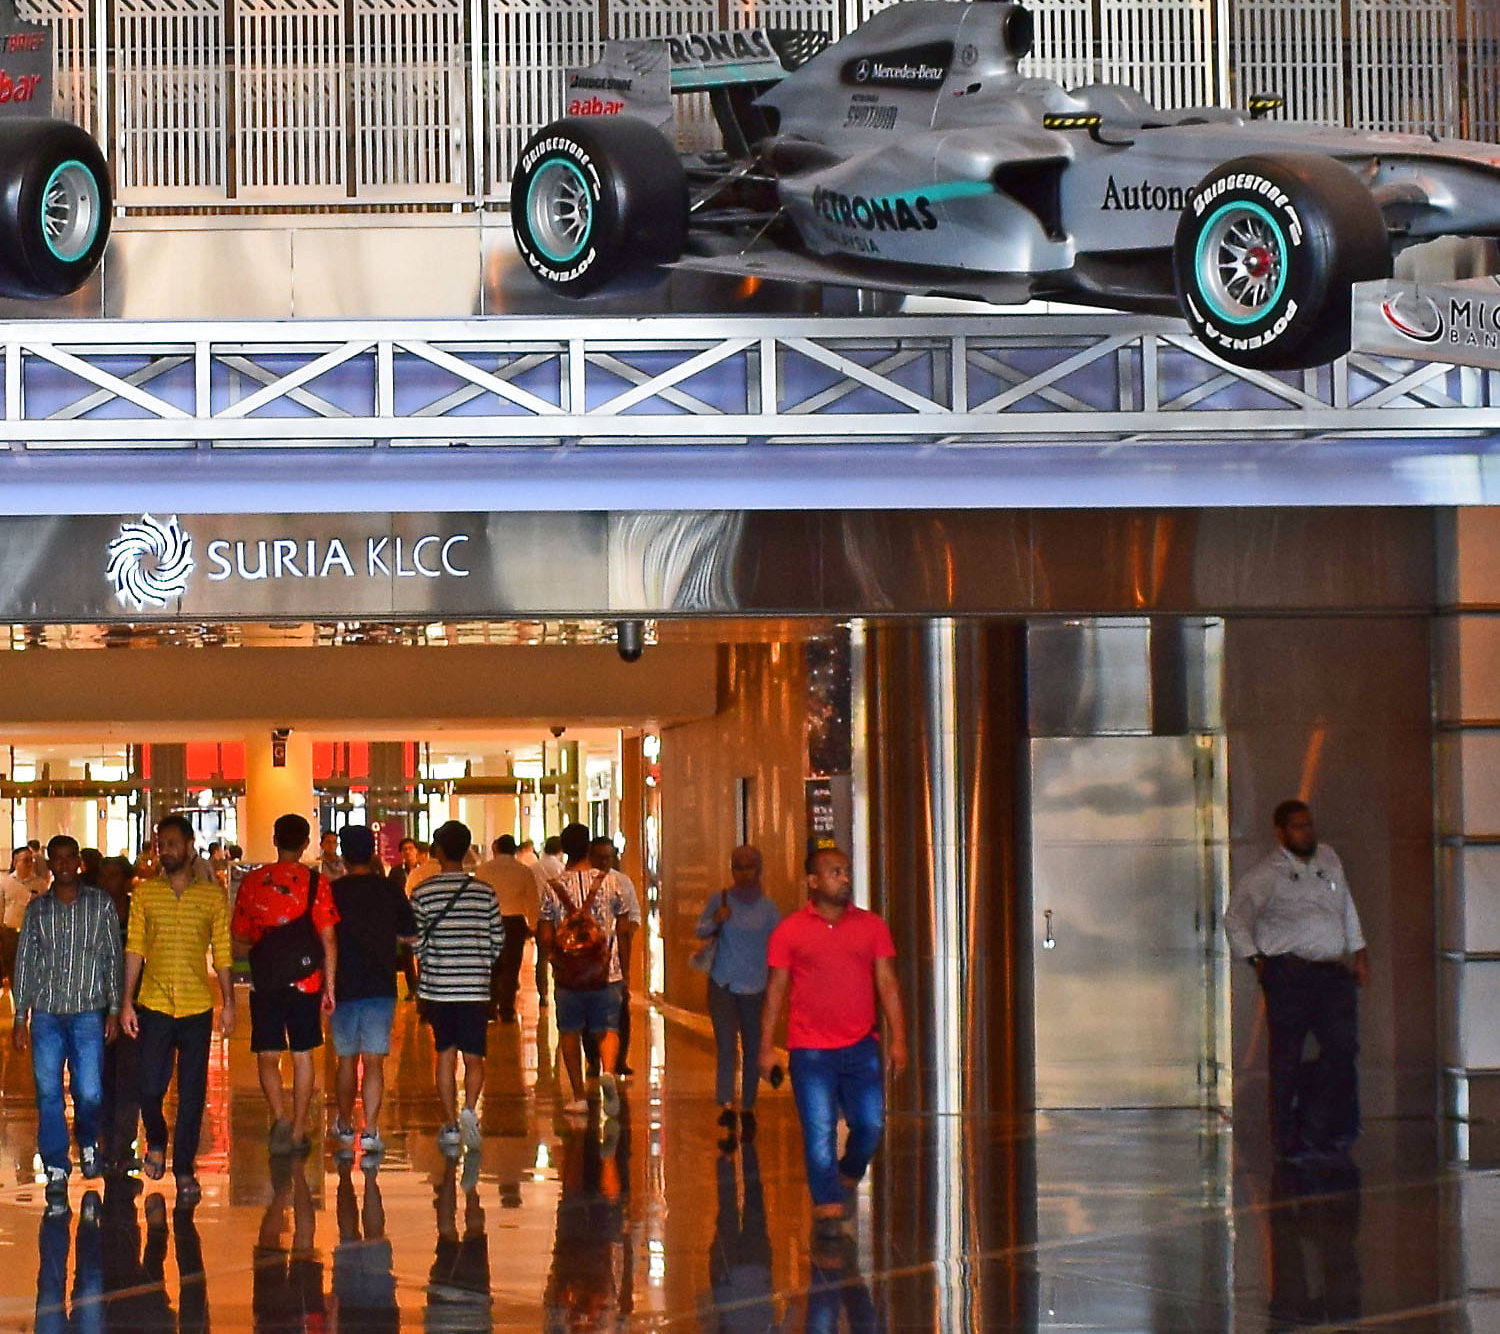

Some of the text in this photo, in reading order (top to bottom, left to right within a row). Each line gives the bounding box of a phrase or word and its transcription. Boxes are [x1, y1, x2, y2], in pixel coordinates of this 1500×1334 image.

[664, 30, 771, 64] RONAS
[871, 63, 944, 80] Mercedes-Benz
[568, 95, 625, 116] aabar
[522, 136, 591, 174] BRIDGESTONE
[812, 184, 939, 232] PETRONAS
[1192, 173, 1289, 218] BRIDGESTONE
[528, 247, 597, 282] POTENZA
[1205, 299, 1299, 351] POTENZA
[206, 535, 471, 581] SURIA KLCC
